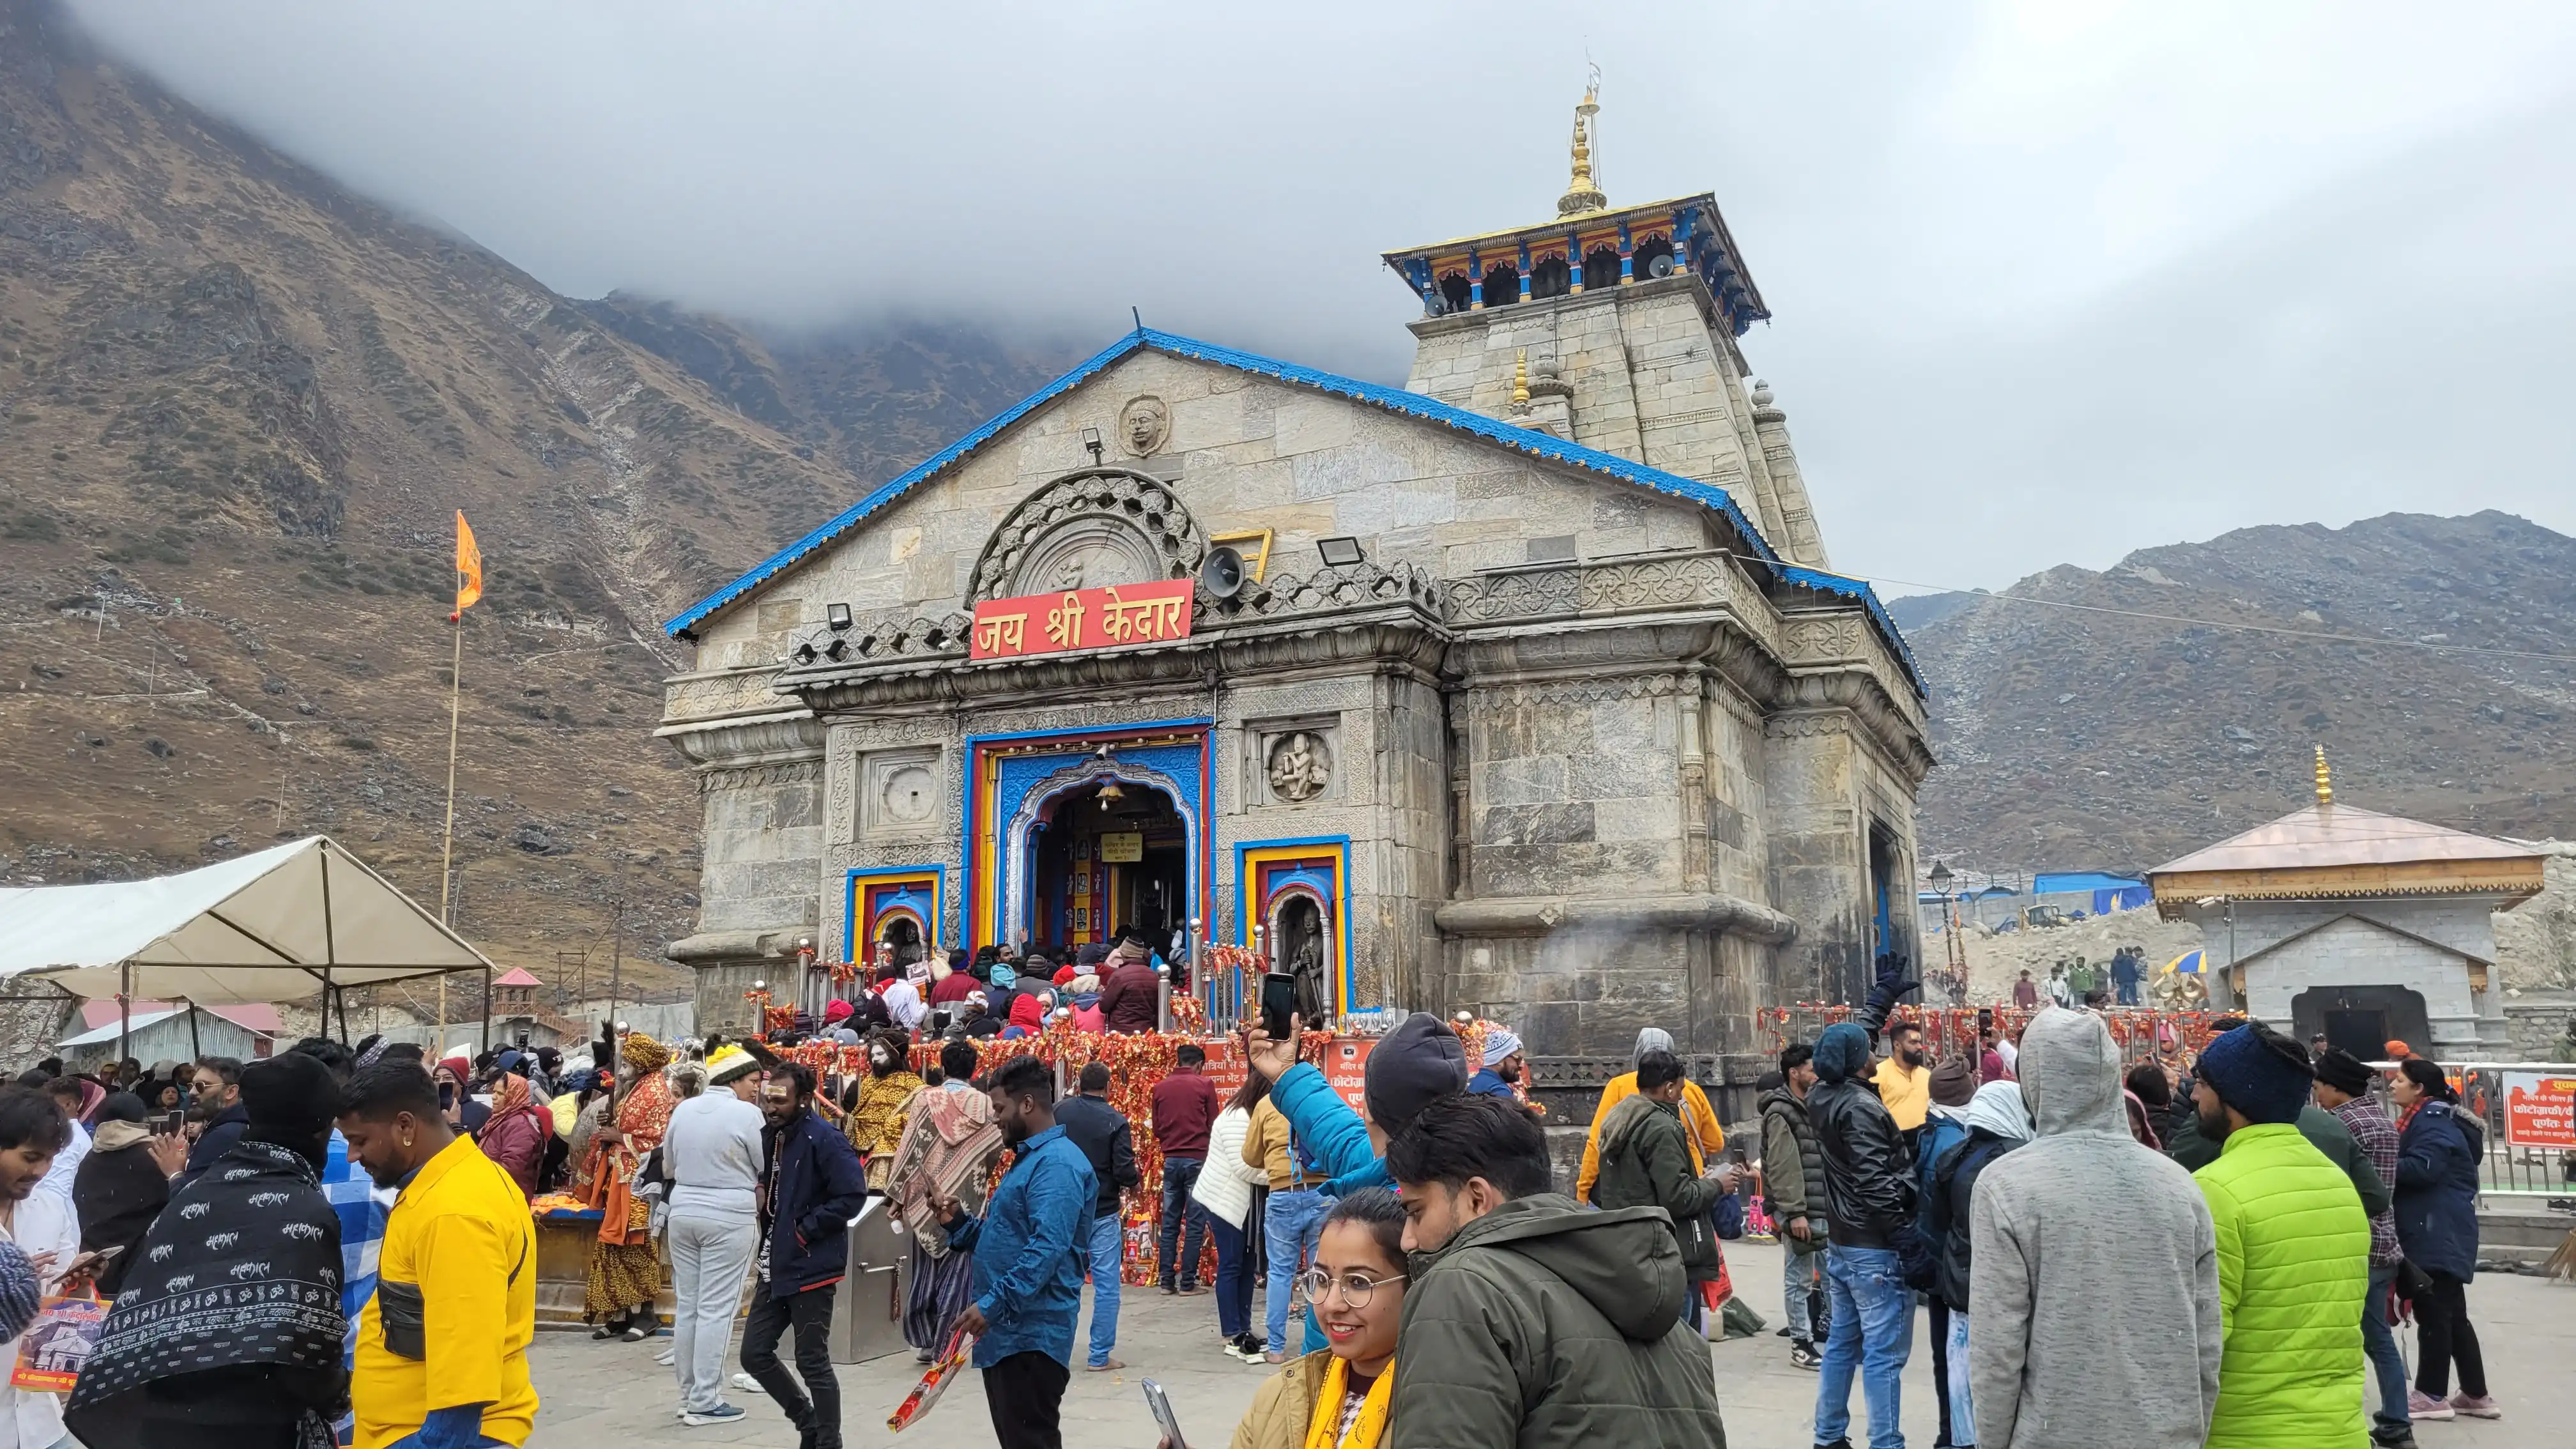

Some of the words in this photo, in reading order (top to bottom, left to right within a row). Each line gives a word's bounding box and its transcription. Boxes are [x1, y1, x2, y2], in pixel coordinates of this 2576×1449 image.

[978, 613, 1027, 655] जय
[1044, 592, 1085, 648] श्री
[1103, 586, 1186, 643] केदार
[1340, 1061, 1356, 1071] मंदिर
[1227, 1072, 1240, 1083] भेंट
[249, 1192, 289, 1208] महाकाल
[181, 1201, 210, 1219] महाकाल
[206, 1230, 239, 1250] महाकाल
[282, 1222, 323, 1241] महाकाल
[230, 1261, 270, 1280] महाकाल
[205, 1291, 218, 1307] ॐ
[239, 1287, 253, 1303] ॐ
[270, 1284, 285, 1299] ॐ
[305, 1289, 319, 1303] ॐ
